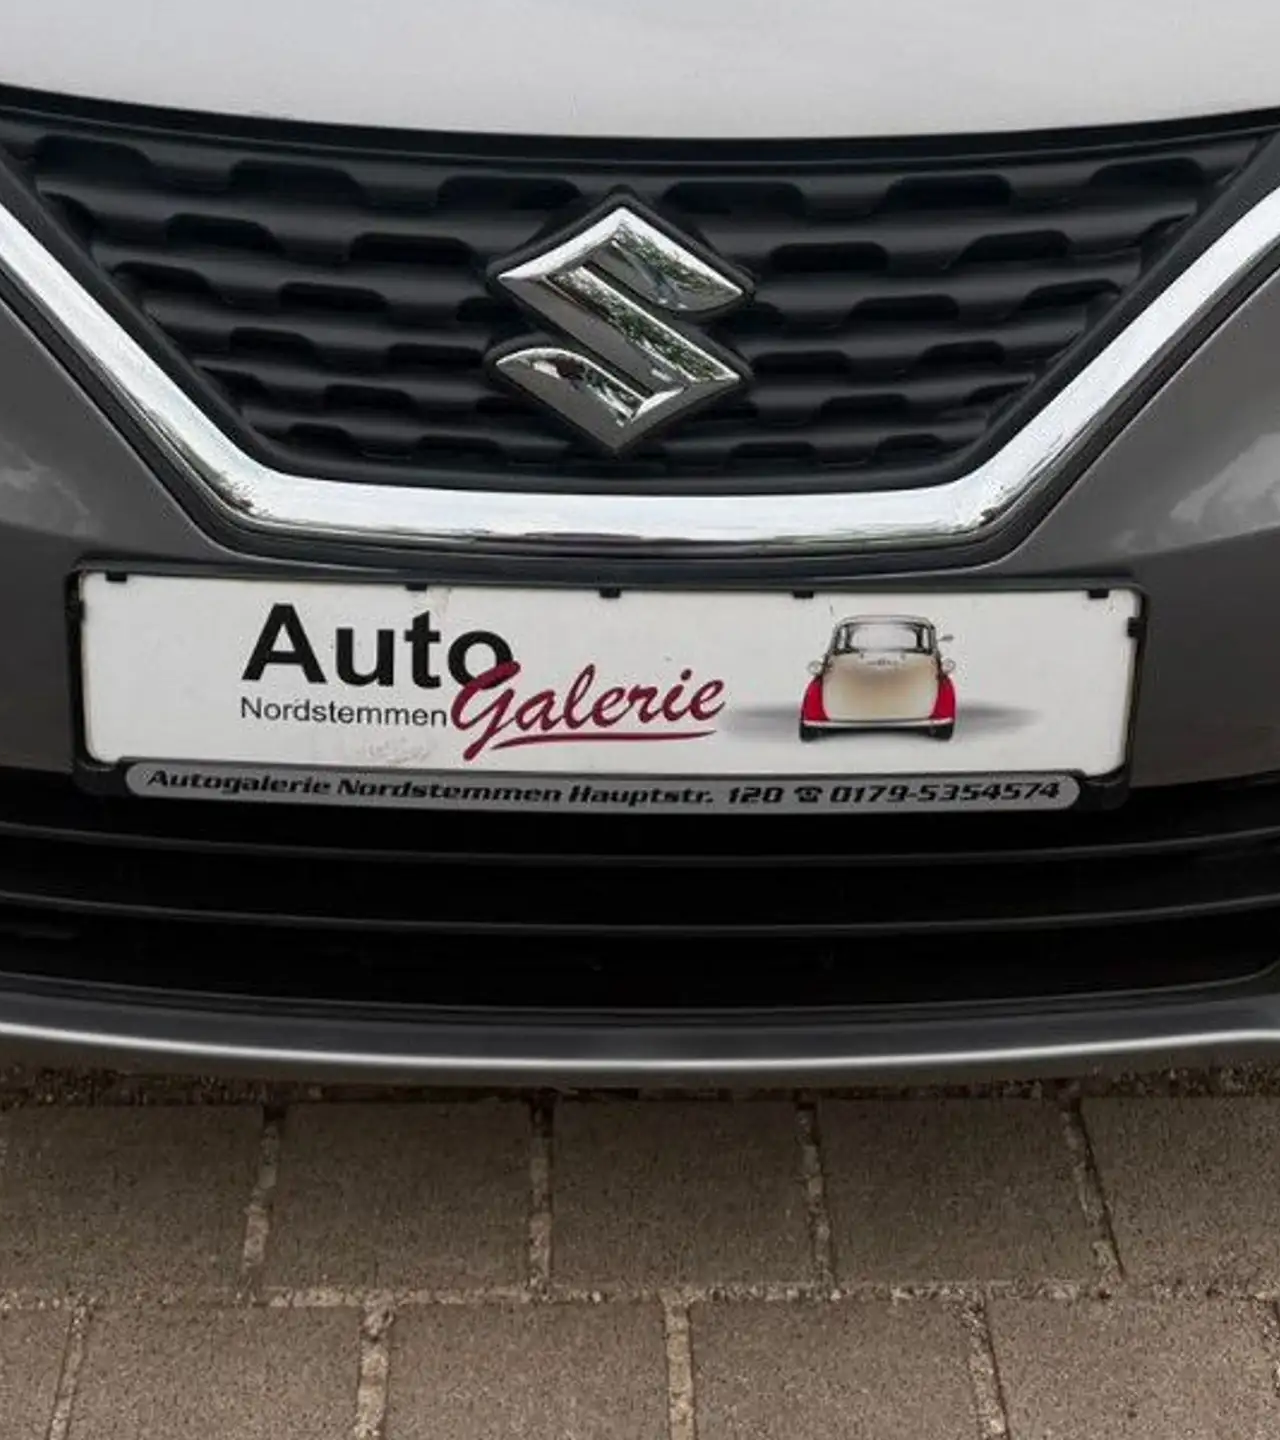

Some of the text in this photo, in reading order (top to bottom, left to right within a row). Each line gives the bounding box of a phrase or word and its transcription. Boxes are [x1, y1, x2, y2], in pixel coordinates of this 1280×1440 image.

[241, 602, 515, 690] Auto
[240, 696, 447, 728] Nordstemmen
[450, 659, 728, 761] Galerie
[146, 769, 1060, 808] Autogalerie Nordstemmen Hauptstr. 120 0179-5354574
